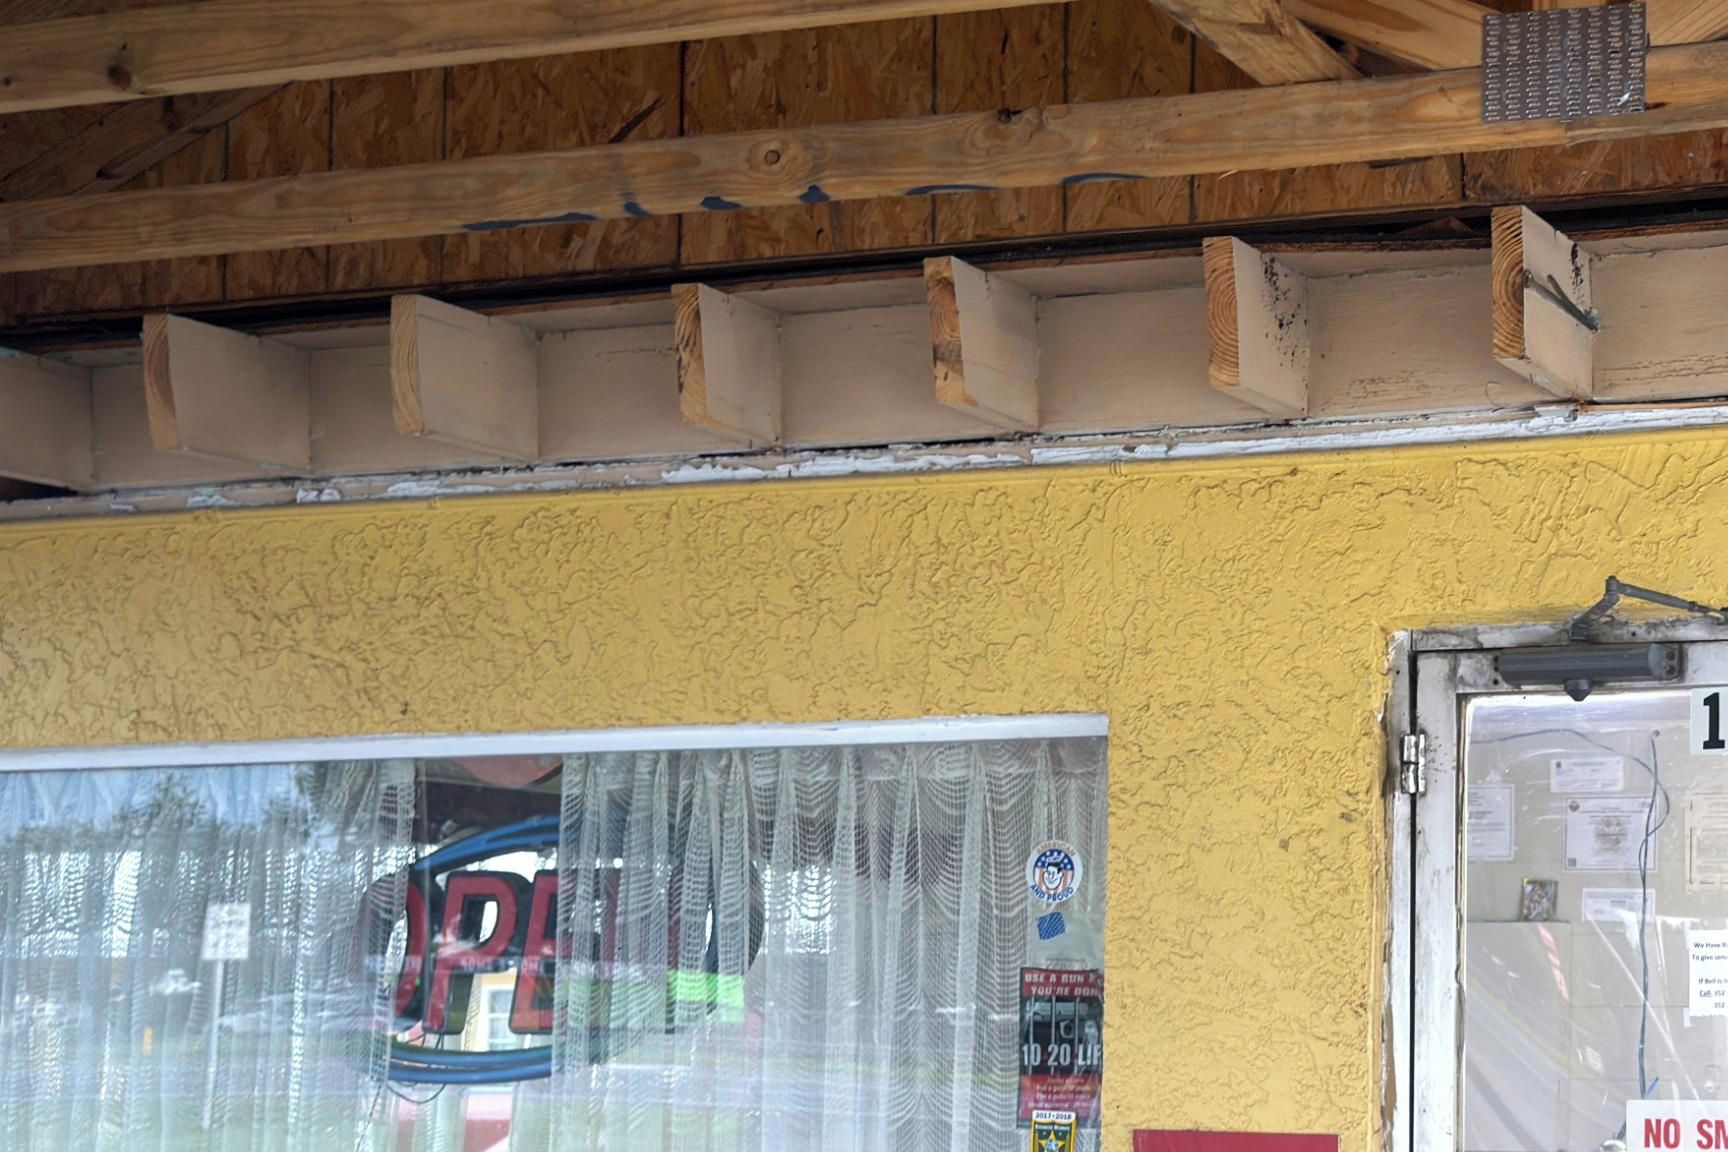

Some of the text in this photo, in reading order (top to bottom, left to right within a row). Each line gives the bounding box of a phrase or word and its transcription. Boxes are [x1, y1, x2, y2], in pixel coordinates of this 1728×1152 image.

[1030, 884, 1074, 902] AND PROUD
[1701, 954, 1713, 962] give
[1025, 973, 1044, 983] USE
[1049, 974, 1057, 982] A
[1032, 986, 1069, 996] YOU'RE
[1022, 1043, 1041, 1066] 10
[1047, 1043, 1071, 1066] 20
[1643, 1118, 1681, 1149] NO
